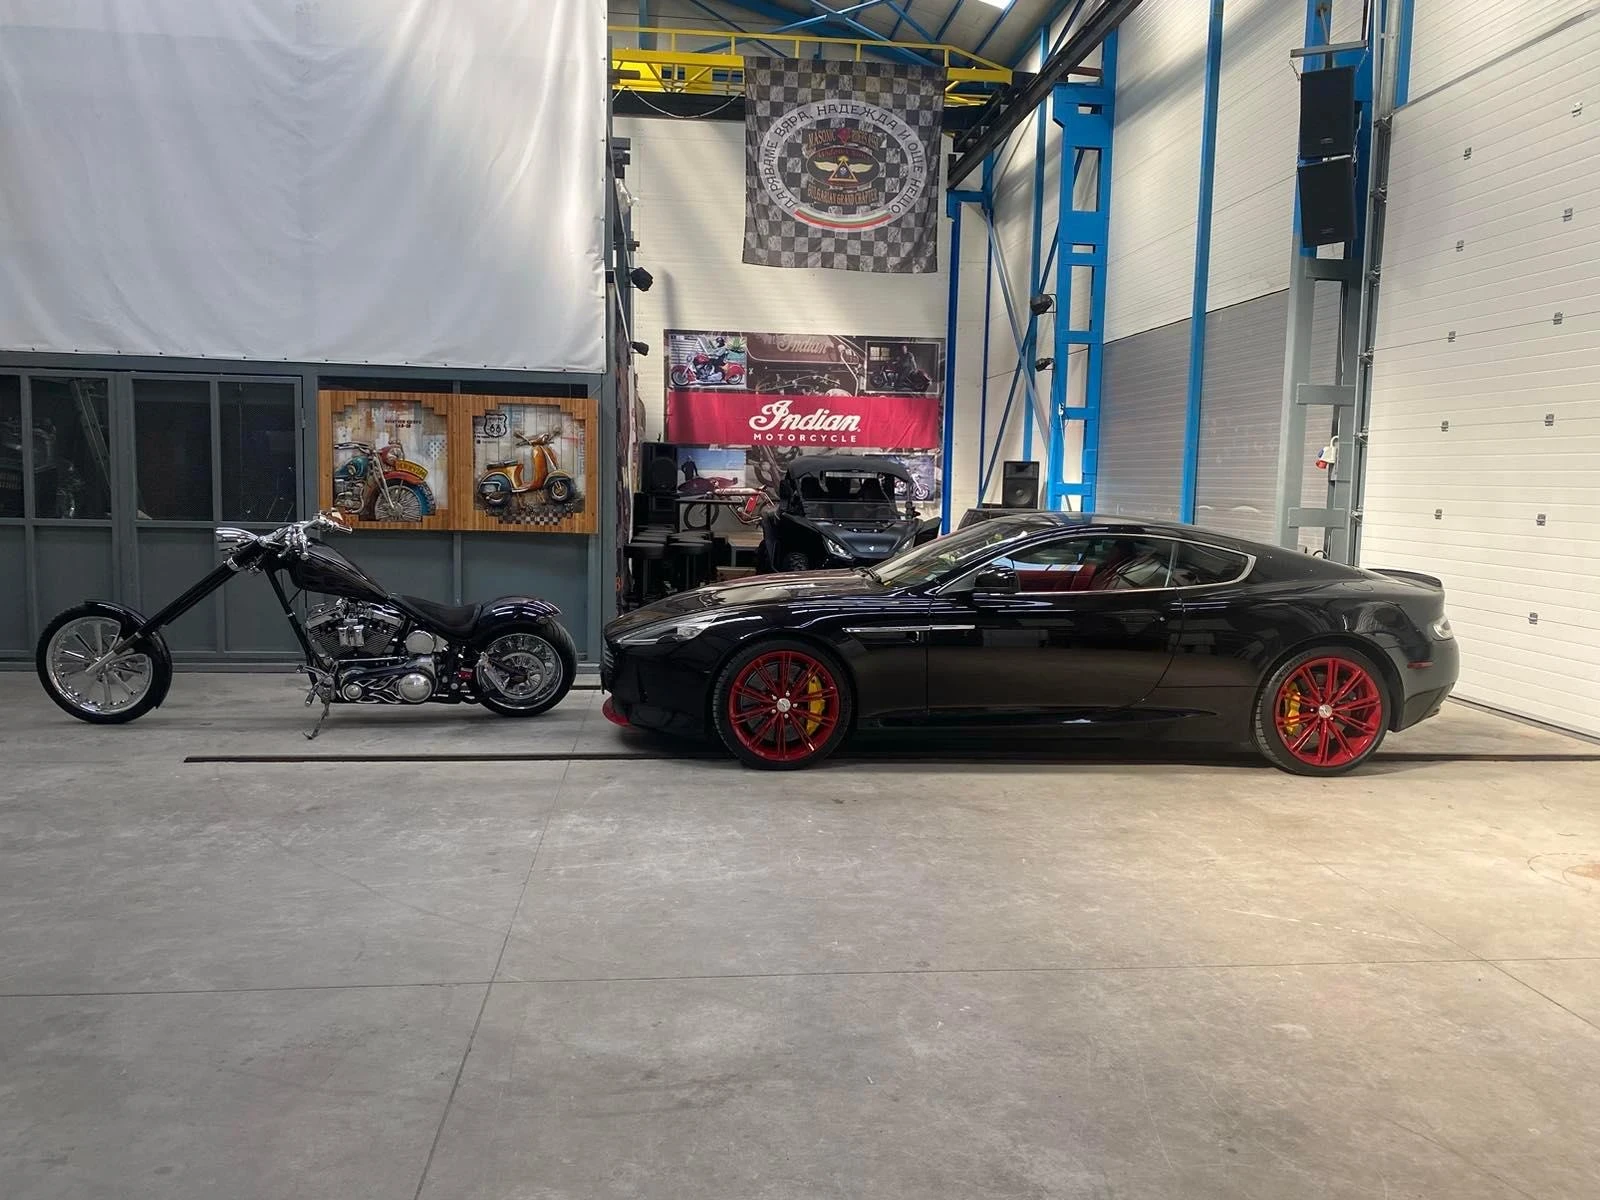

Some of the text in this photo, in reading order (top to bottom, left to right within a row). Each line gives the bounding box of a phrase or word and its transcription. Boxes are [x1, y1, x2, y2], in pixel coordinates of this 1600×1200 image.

[764, 140, 797, 208] ДАРЯВАМЕ
[817, 104, 898, 130] НАДЕЖДА
[897, 130, 911, 141] И
[908, 142, 923, 174] ОЩЕ
[777, 334, 827, 354] Indian
[748, 400, 861, 432] Indian
[489, 423, 502, 434] 66
[753, 433, 857, 443] MOTORCYCLE
